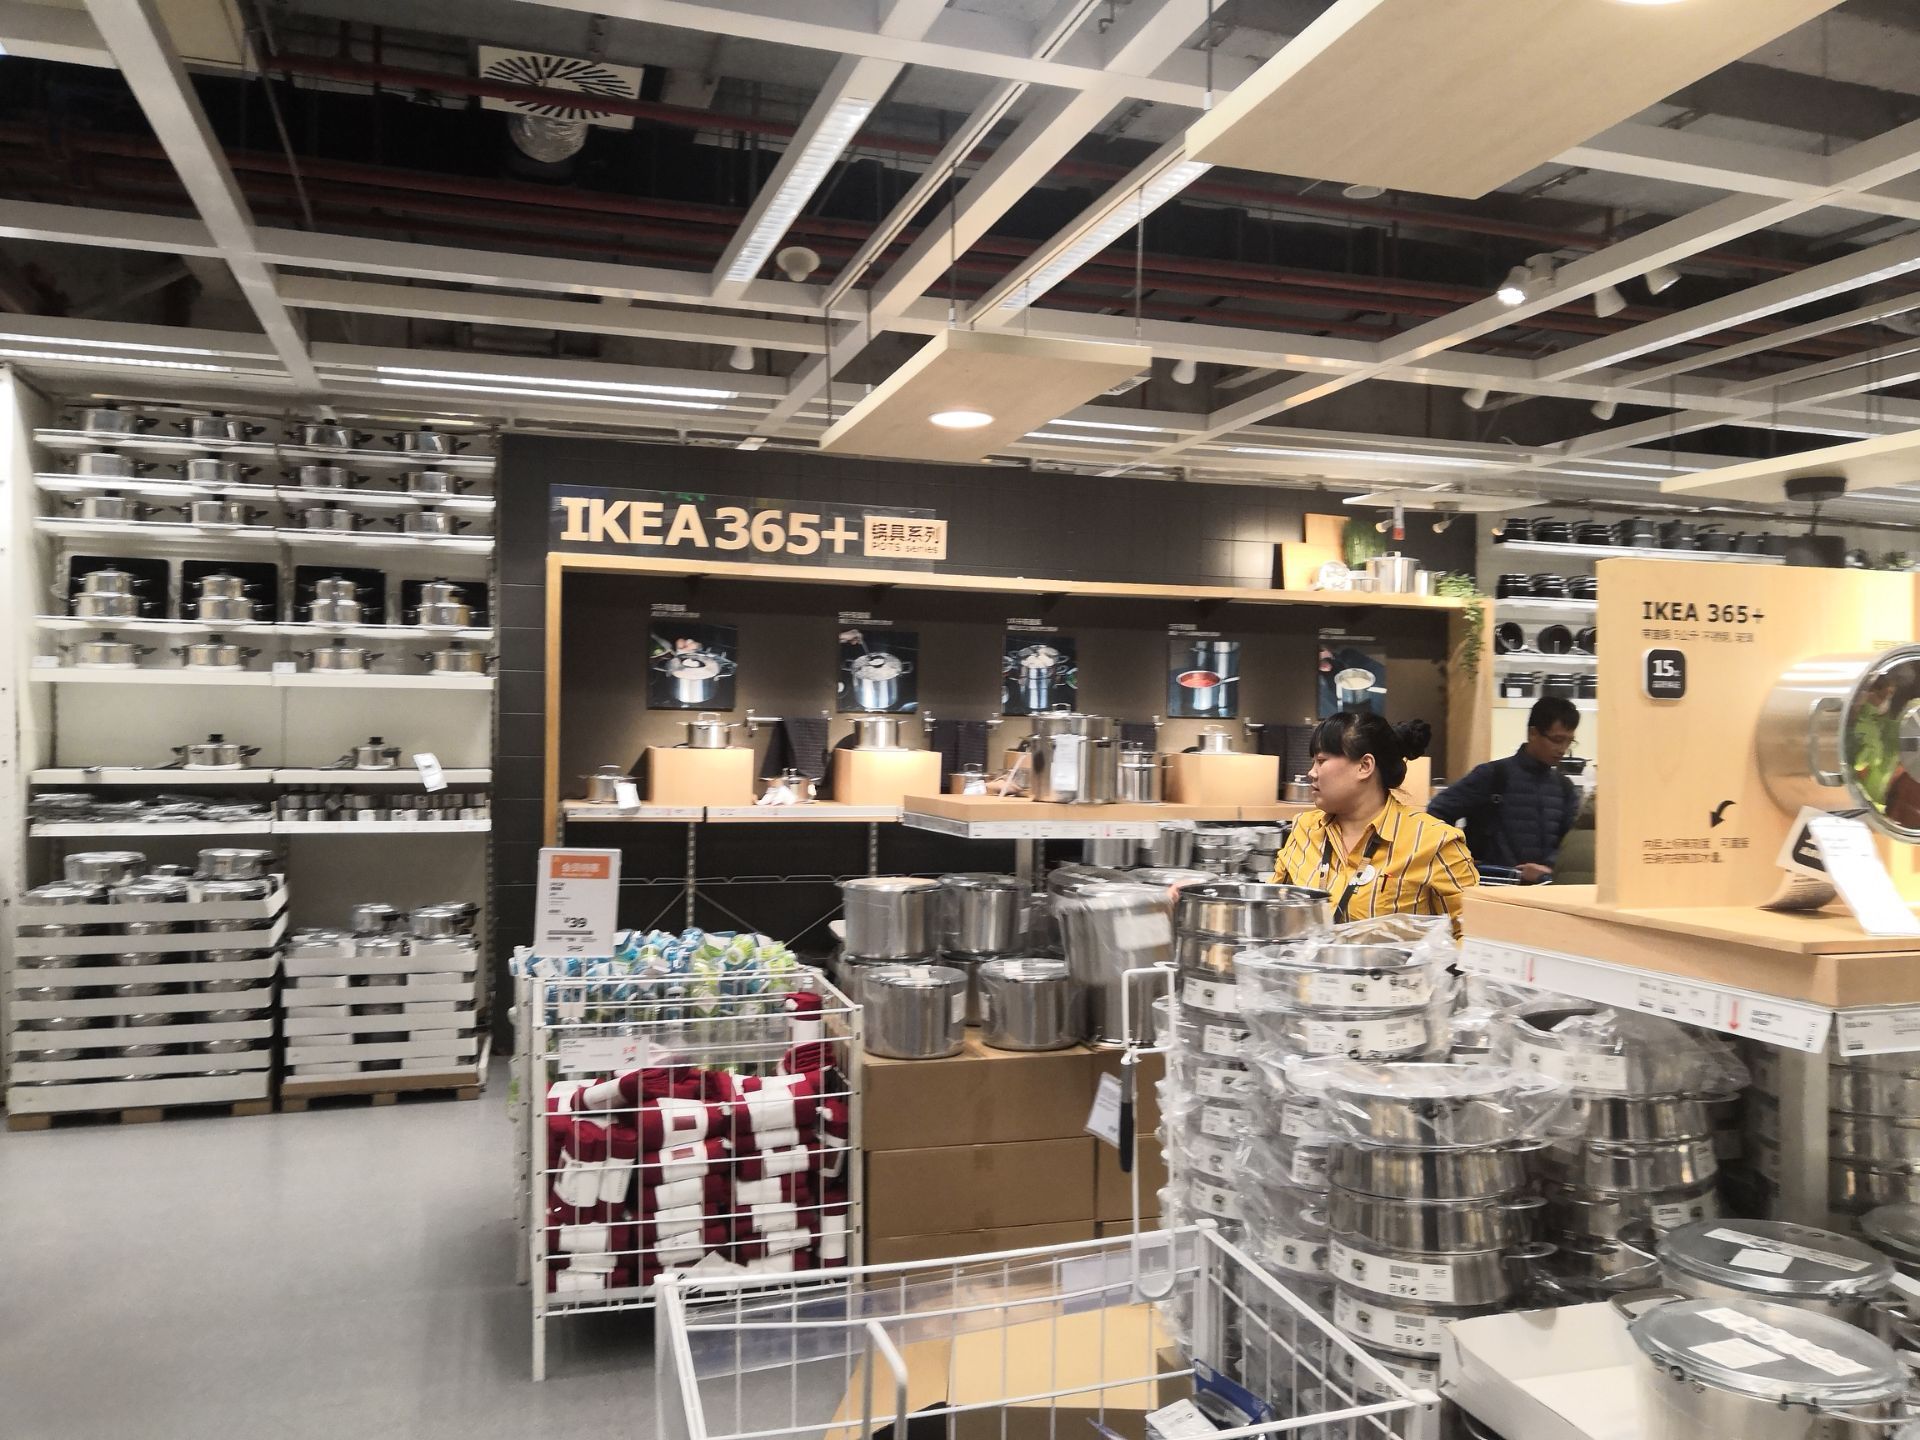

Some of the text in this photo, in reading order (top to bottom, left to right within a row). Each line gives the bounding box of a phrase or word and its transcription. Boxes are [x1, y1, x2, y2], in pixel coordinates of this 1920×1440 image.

[560, 497, 858, 555] IKEA 365+
[1642, 601, 1765, 624] IKEA 365+
[1652, 659, 1674, 677] 15
